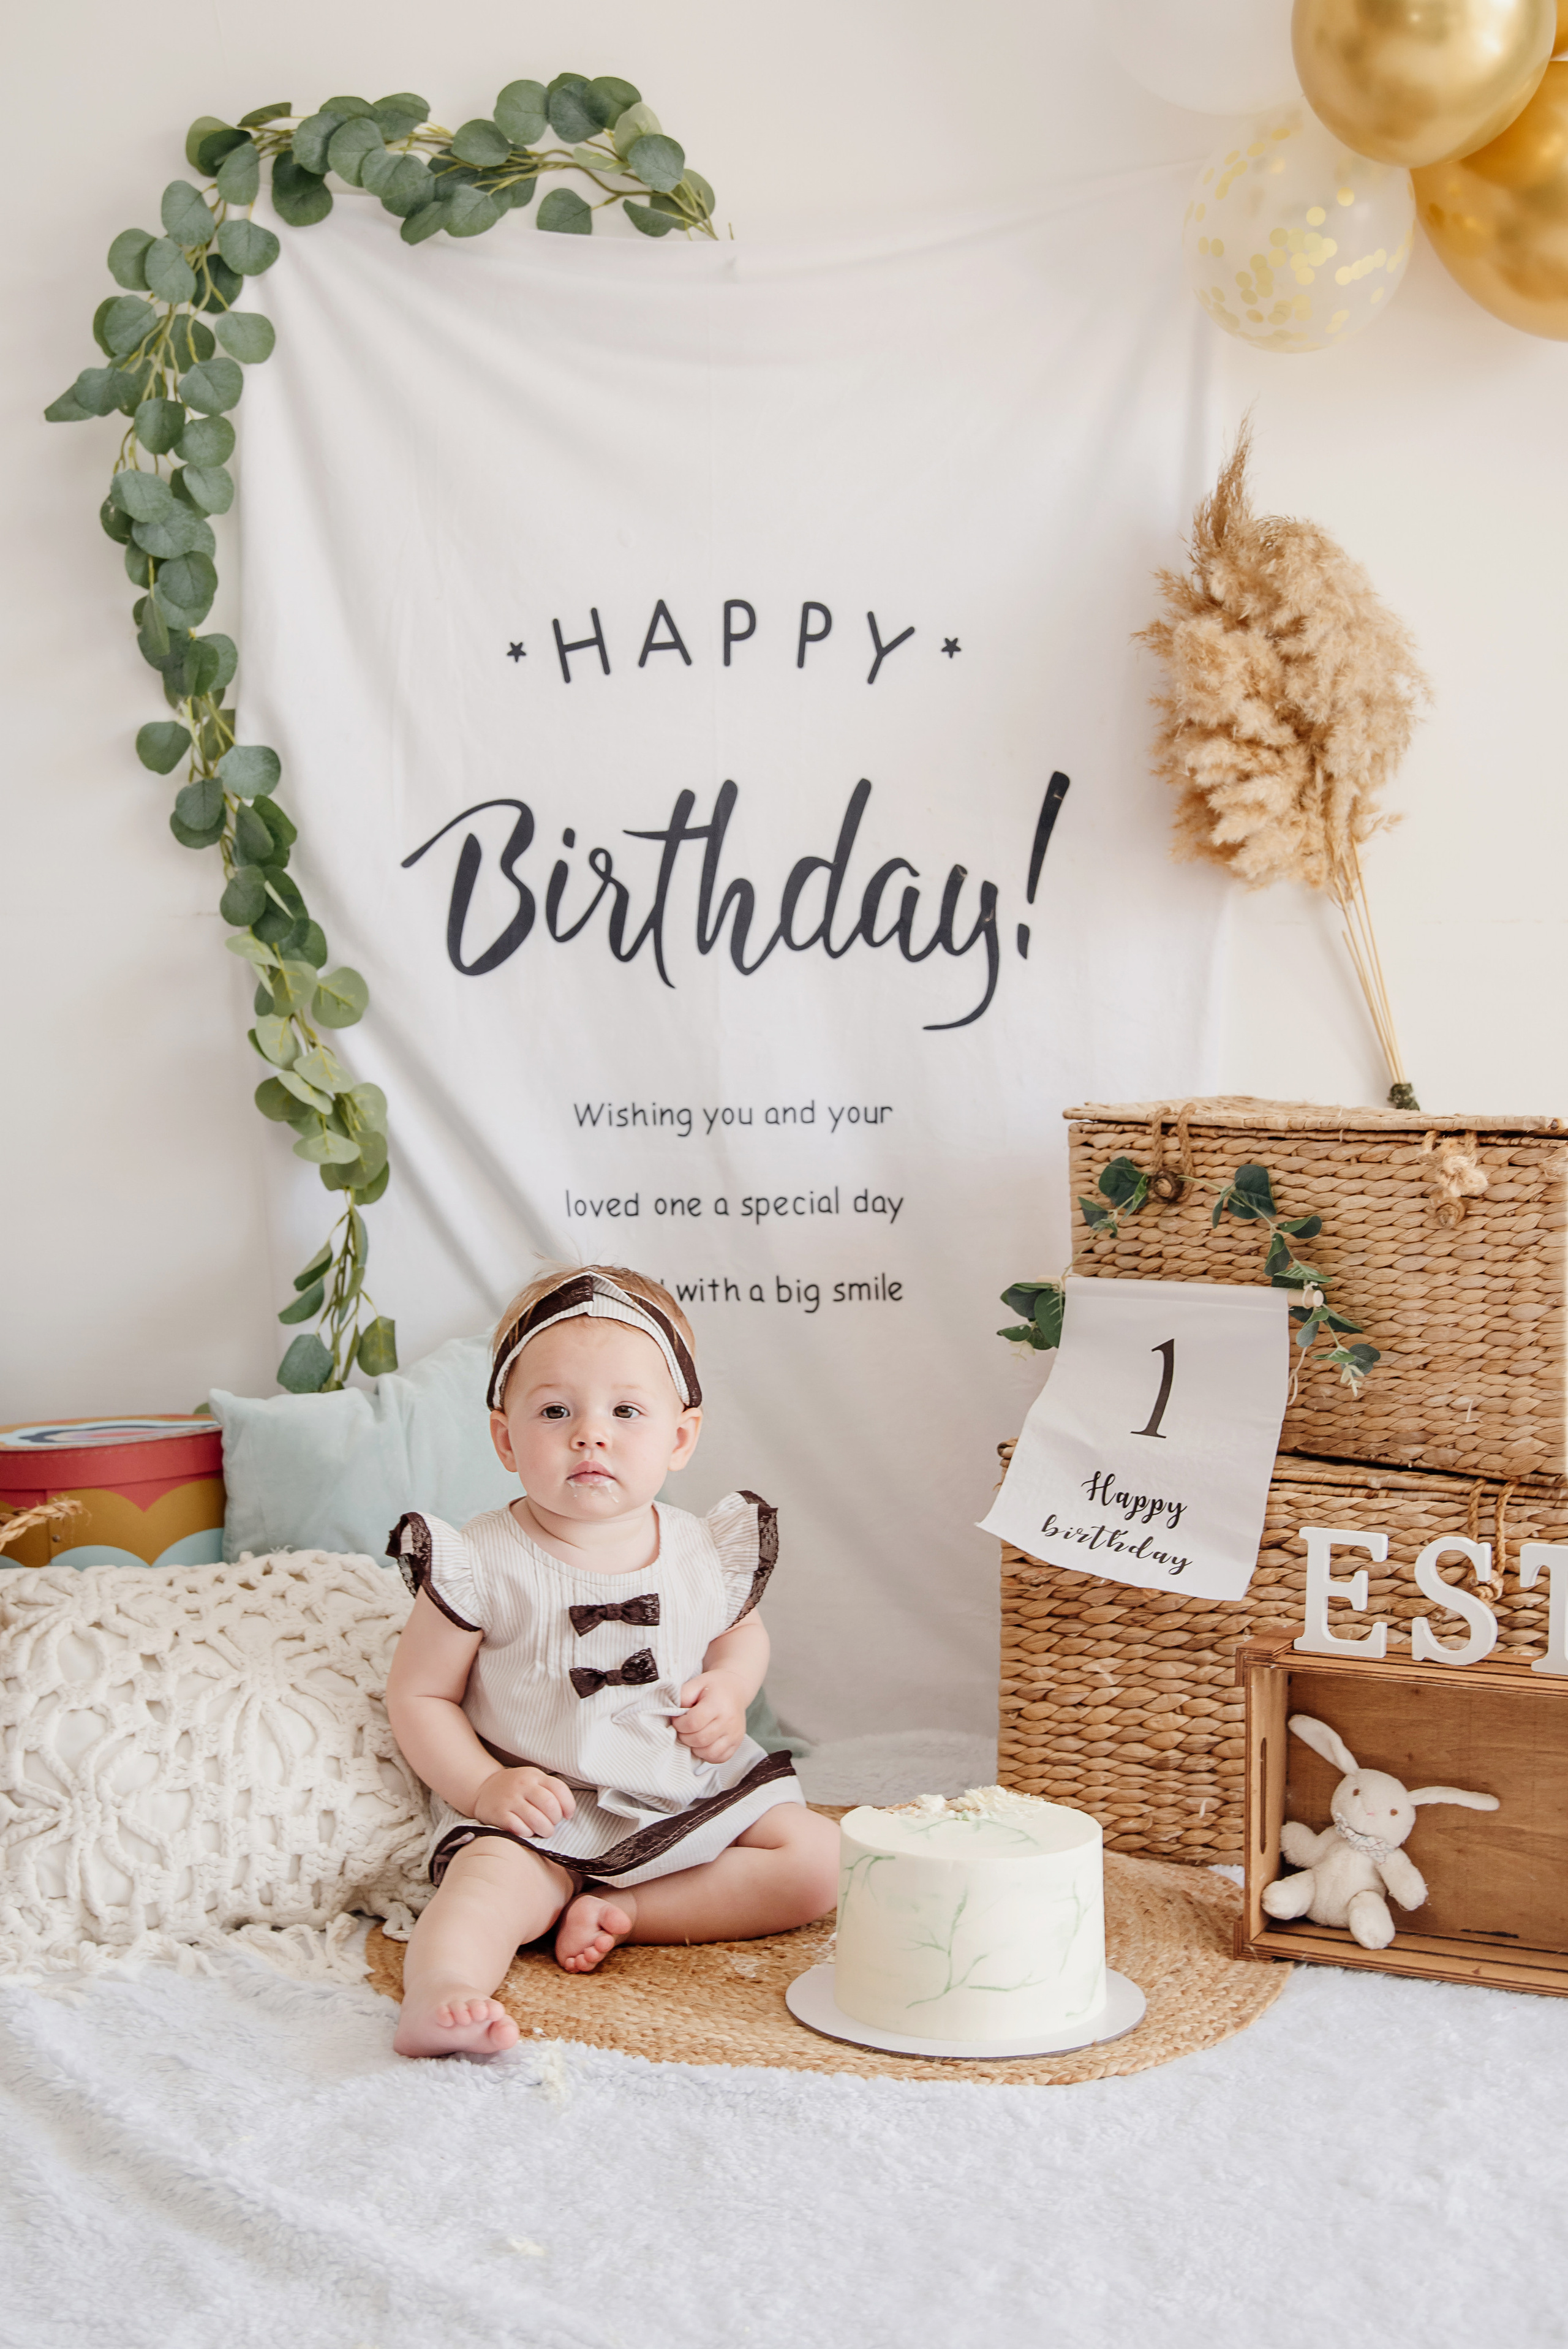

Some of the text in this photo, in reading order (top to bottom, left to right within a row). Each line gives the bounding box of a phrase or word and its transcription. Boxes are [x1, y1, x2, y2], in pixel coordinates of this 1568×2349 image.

[551, 598, 916, 685] HAPPY
[401, 770, 1071, 1031] Birthday!
[573, 1099, 894, 1137] Wishing you and your
[565, 1186, 904, 1226] loved one a special day
[676, 1272, 904, 1314] with a big smile
[1129, 1338, 1175, 1439] 1
[1080, 1470, 1188, 1529] Happy
[1041, 1514, 1193, 1575] birthday
[1293, 1526, 1568, 1676] EST
